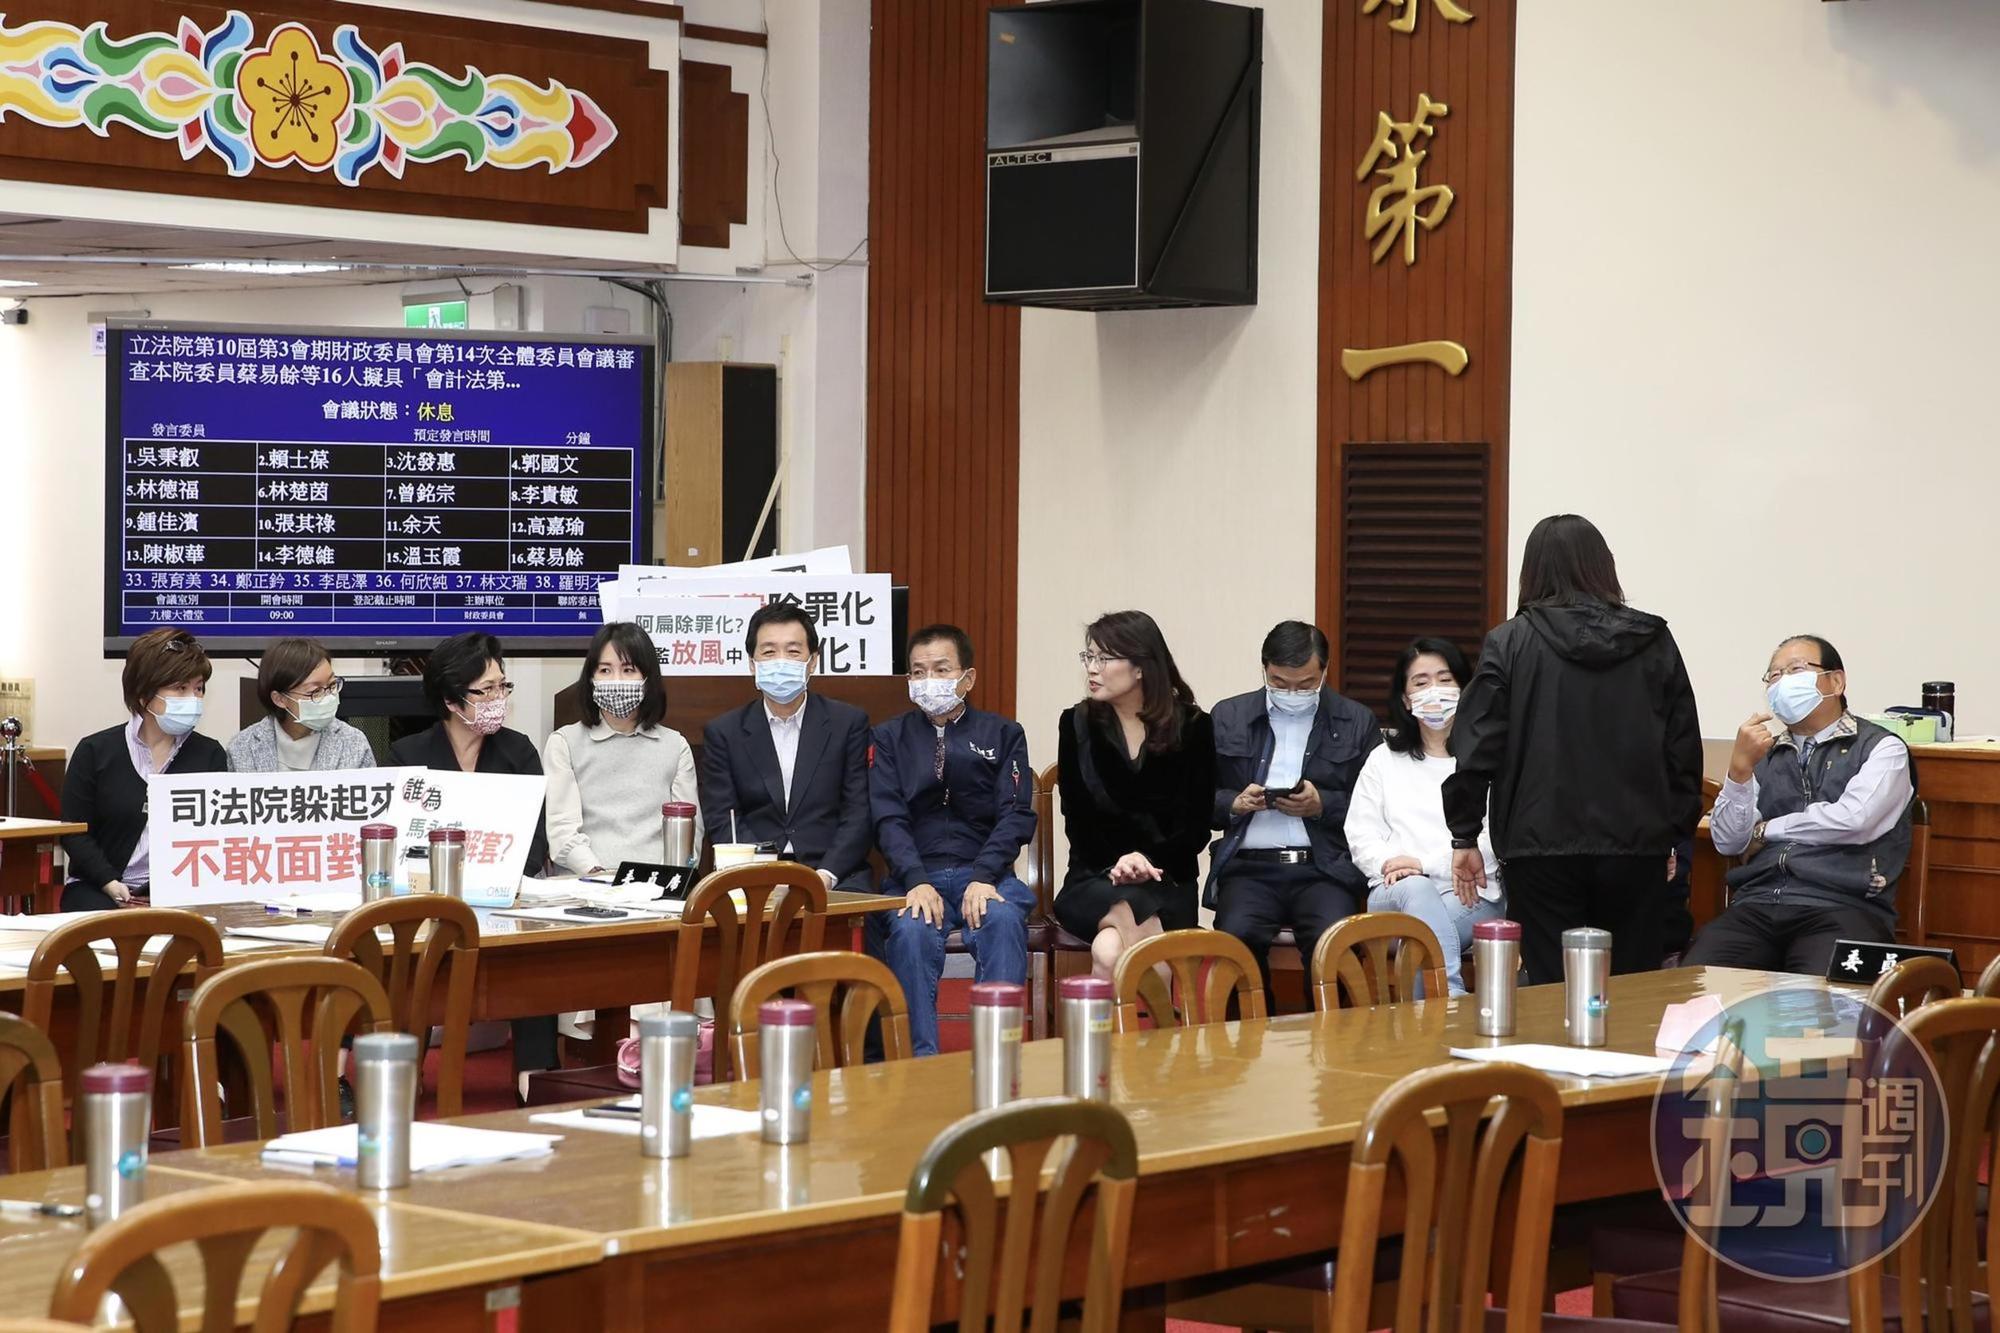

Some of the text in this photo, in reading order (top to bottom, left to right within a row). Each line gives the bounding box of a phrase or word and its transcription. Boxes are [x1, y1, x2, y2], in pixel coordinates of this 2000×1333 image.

[994, 152, 1048, 166] ALTEC
[129, 334, 635, 369] 立法院第10屆第3會期財政委員會第14次全體委員會議審
[151, 422, 206, 437] 發言委員
[413, 428, 490, 443] 預定發言時間
[565, 431, 592, 445] 分鐘
[127, 447, 200, 468] 1.吳秉叡
[259, 449, 330, 470] 2.賴士葆
[387, 451, 455, 472] 3.沈發惠
[512, 454, 579, 474] 4.郭國文
[126, 479, 199, 500] 5.林德福
[258, 481, 329, 501] 6.林楚茵
[387, 483, 456, 504] 7.曾銘宗
[511, 485, 579, 505] 8.李貴敏
[126, 511, 199, 532] 9.鍾佳濱
[259, 513, 336, 534] 10.張其祿
[387, 515, 442, 535] 11.余天
[512, 516, 585, 536] 12.高嘉瑜
[127, 544, 205, 565] 13.陳椒華
[259, 545, 335, 566] 14.李德維
[387, 547, 461, 567] 15.溫玉霞
[512, 547, 585, 567] 16.蔡易餘
[125, 573, 147, 587] 33.
[151, 573, 202, 589] 張育美
[210, 573, 231, 587] 34.
[235, 573, 286, 590] 鄭正鈐
[293, 574, 314, 587] 35.
[318, 573, 368, 590] 李昆澤
[375, 574, 396, 588] 36.
[400, 574, 448, 590] 何欣純
[456, 574, 476, 588] 37.
[479, 574, 528, 590] 林文瑞
[535, 575, 555, 589] 38.
[260, 594, 303, 606] 開會時間
[269, 610, 294, 620] 09:00
[403, 778, 442, 811] 誰為
